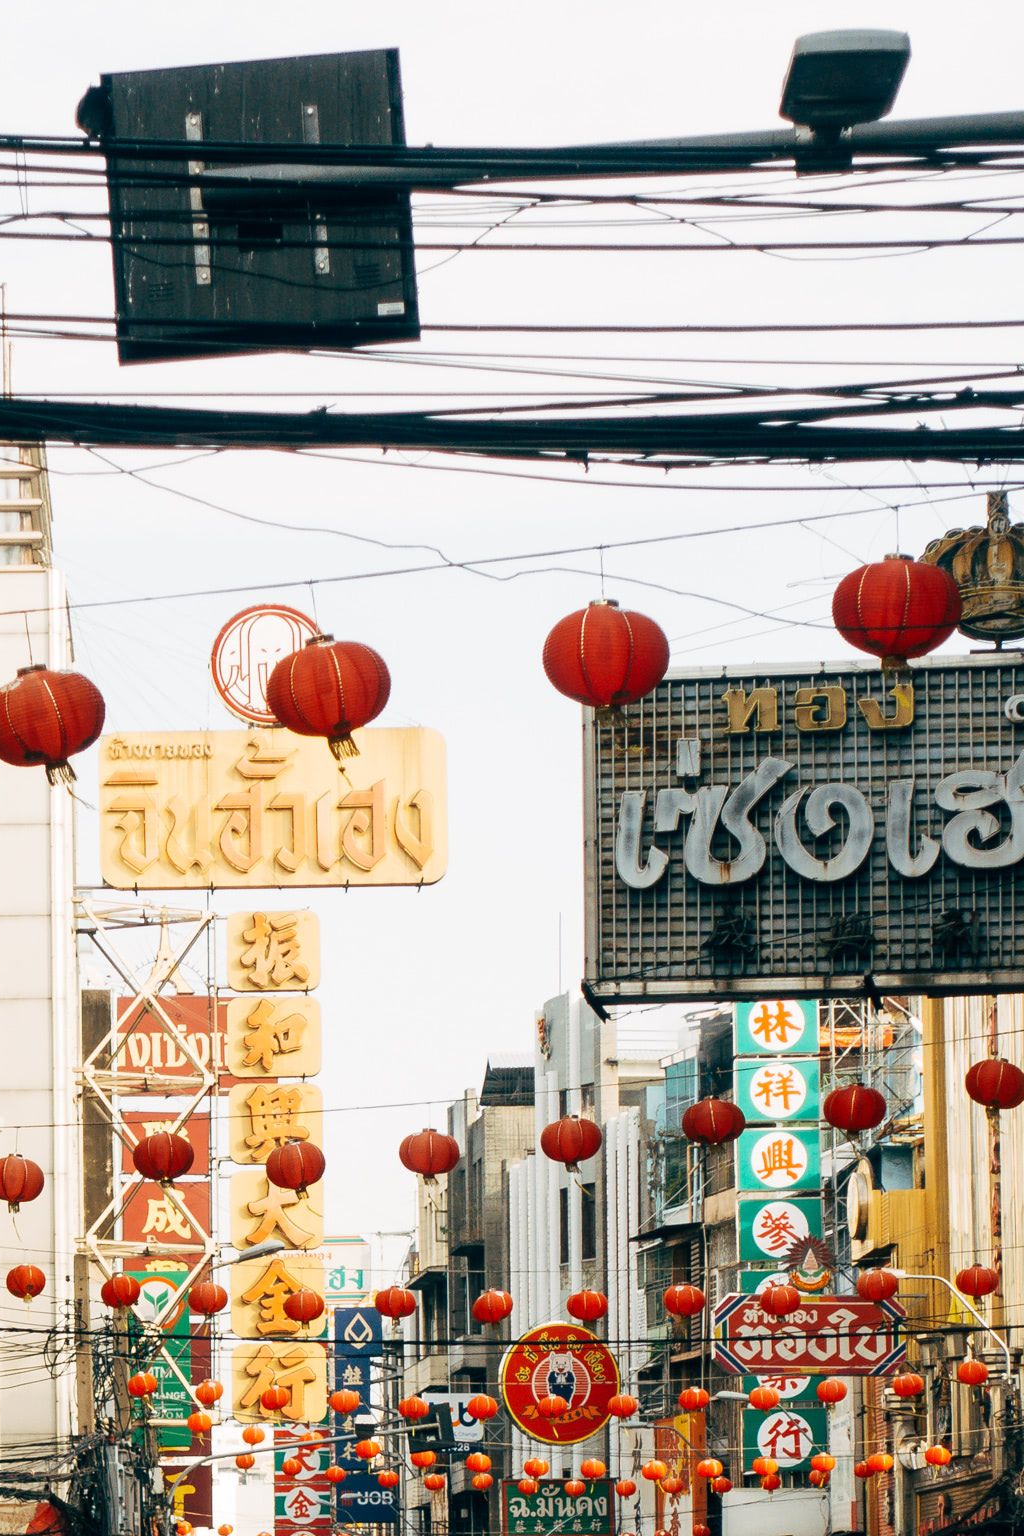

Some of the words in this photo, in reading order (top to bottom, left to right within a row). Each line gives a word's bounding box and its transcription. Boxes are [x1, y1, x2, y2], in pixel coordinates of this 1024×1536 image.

[722, 683, 916, 734] ทอง
[733, 1308, 888, 1362] ทองใบ
[357, 1490, 394, 1506] UOB
[509, 1484, 608, 1518] ฉ.มั่นคง
